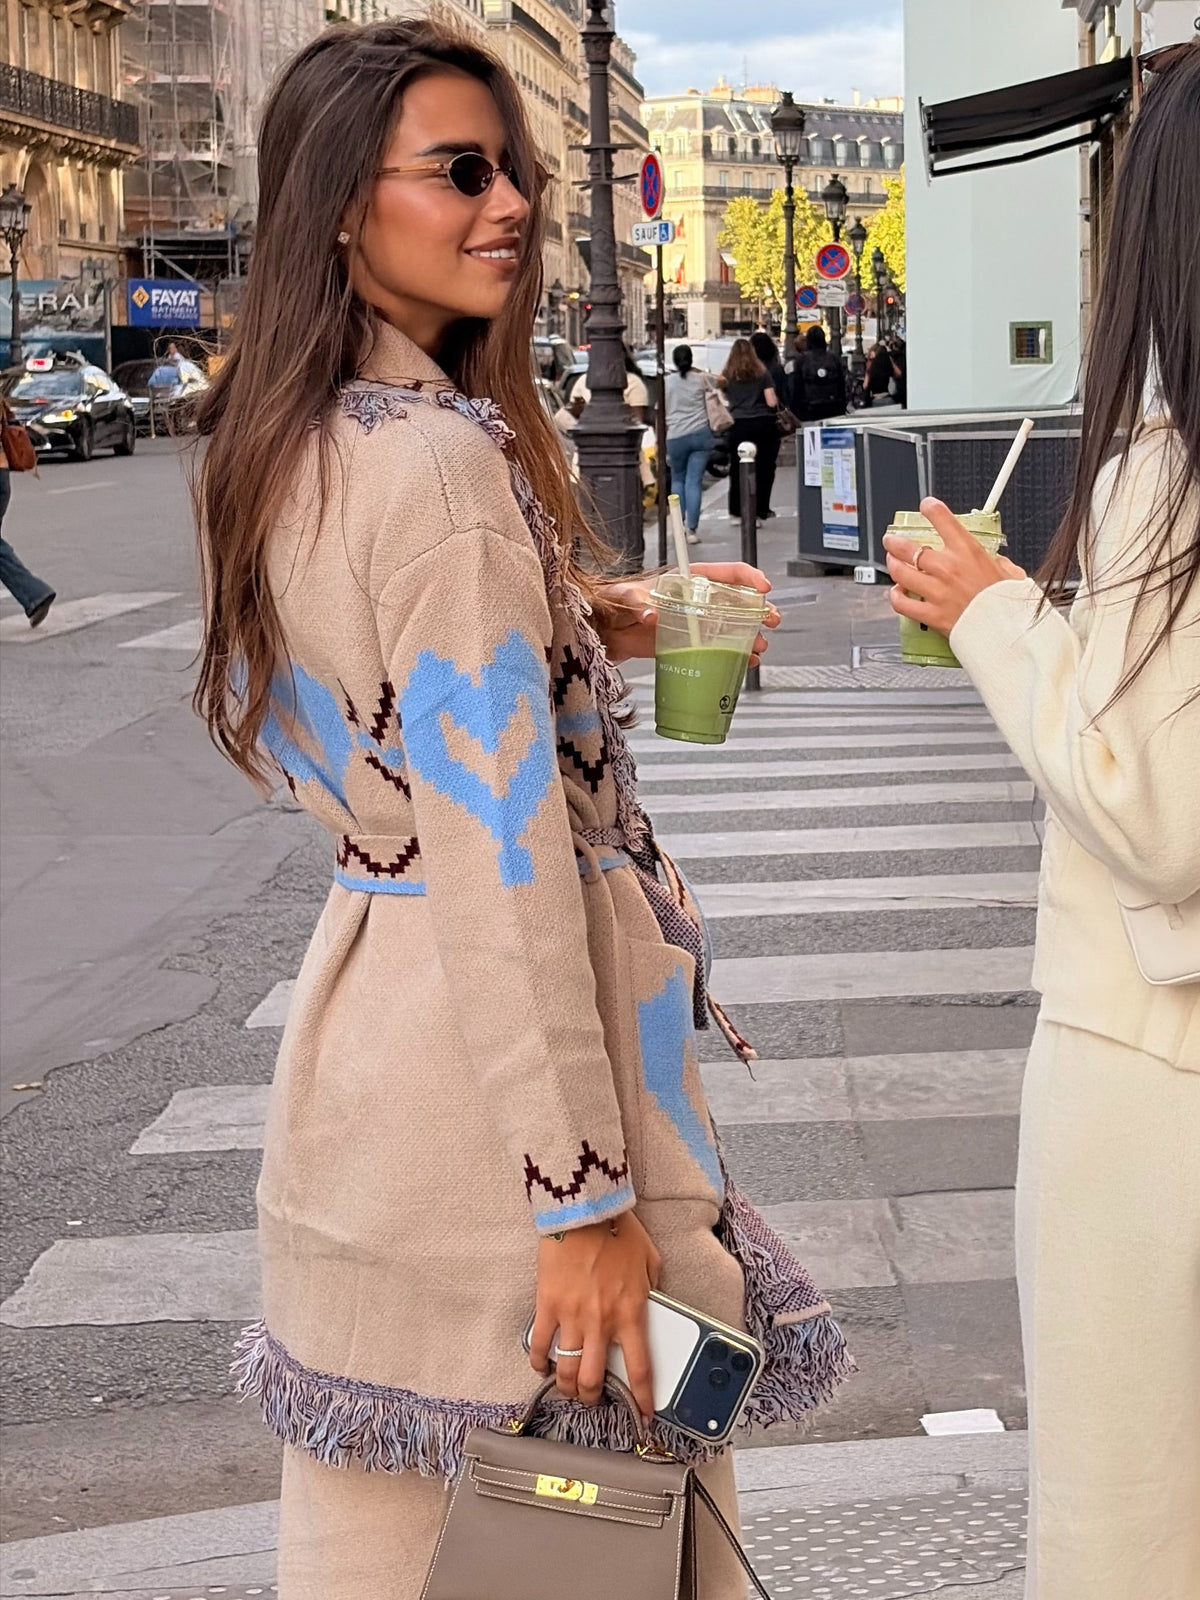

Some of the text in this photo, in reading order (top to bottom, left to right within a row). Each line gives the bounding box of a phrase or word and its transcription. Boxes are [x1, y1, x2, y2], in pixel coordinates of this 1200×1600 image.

[635, 227, 657, 241] SAUF
[151, 288, 198, 306] FAYAT
[659, 663, 701, 678] NUANCES
